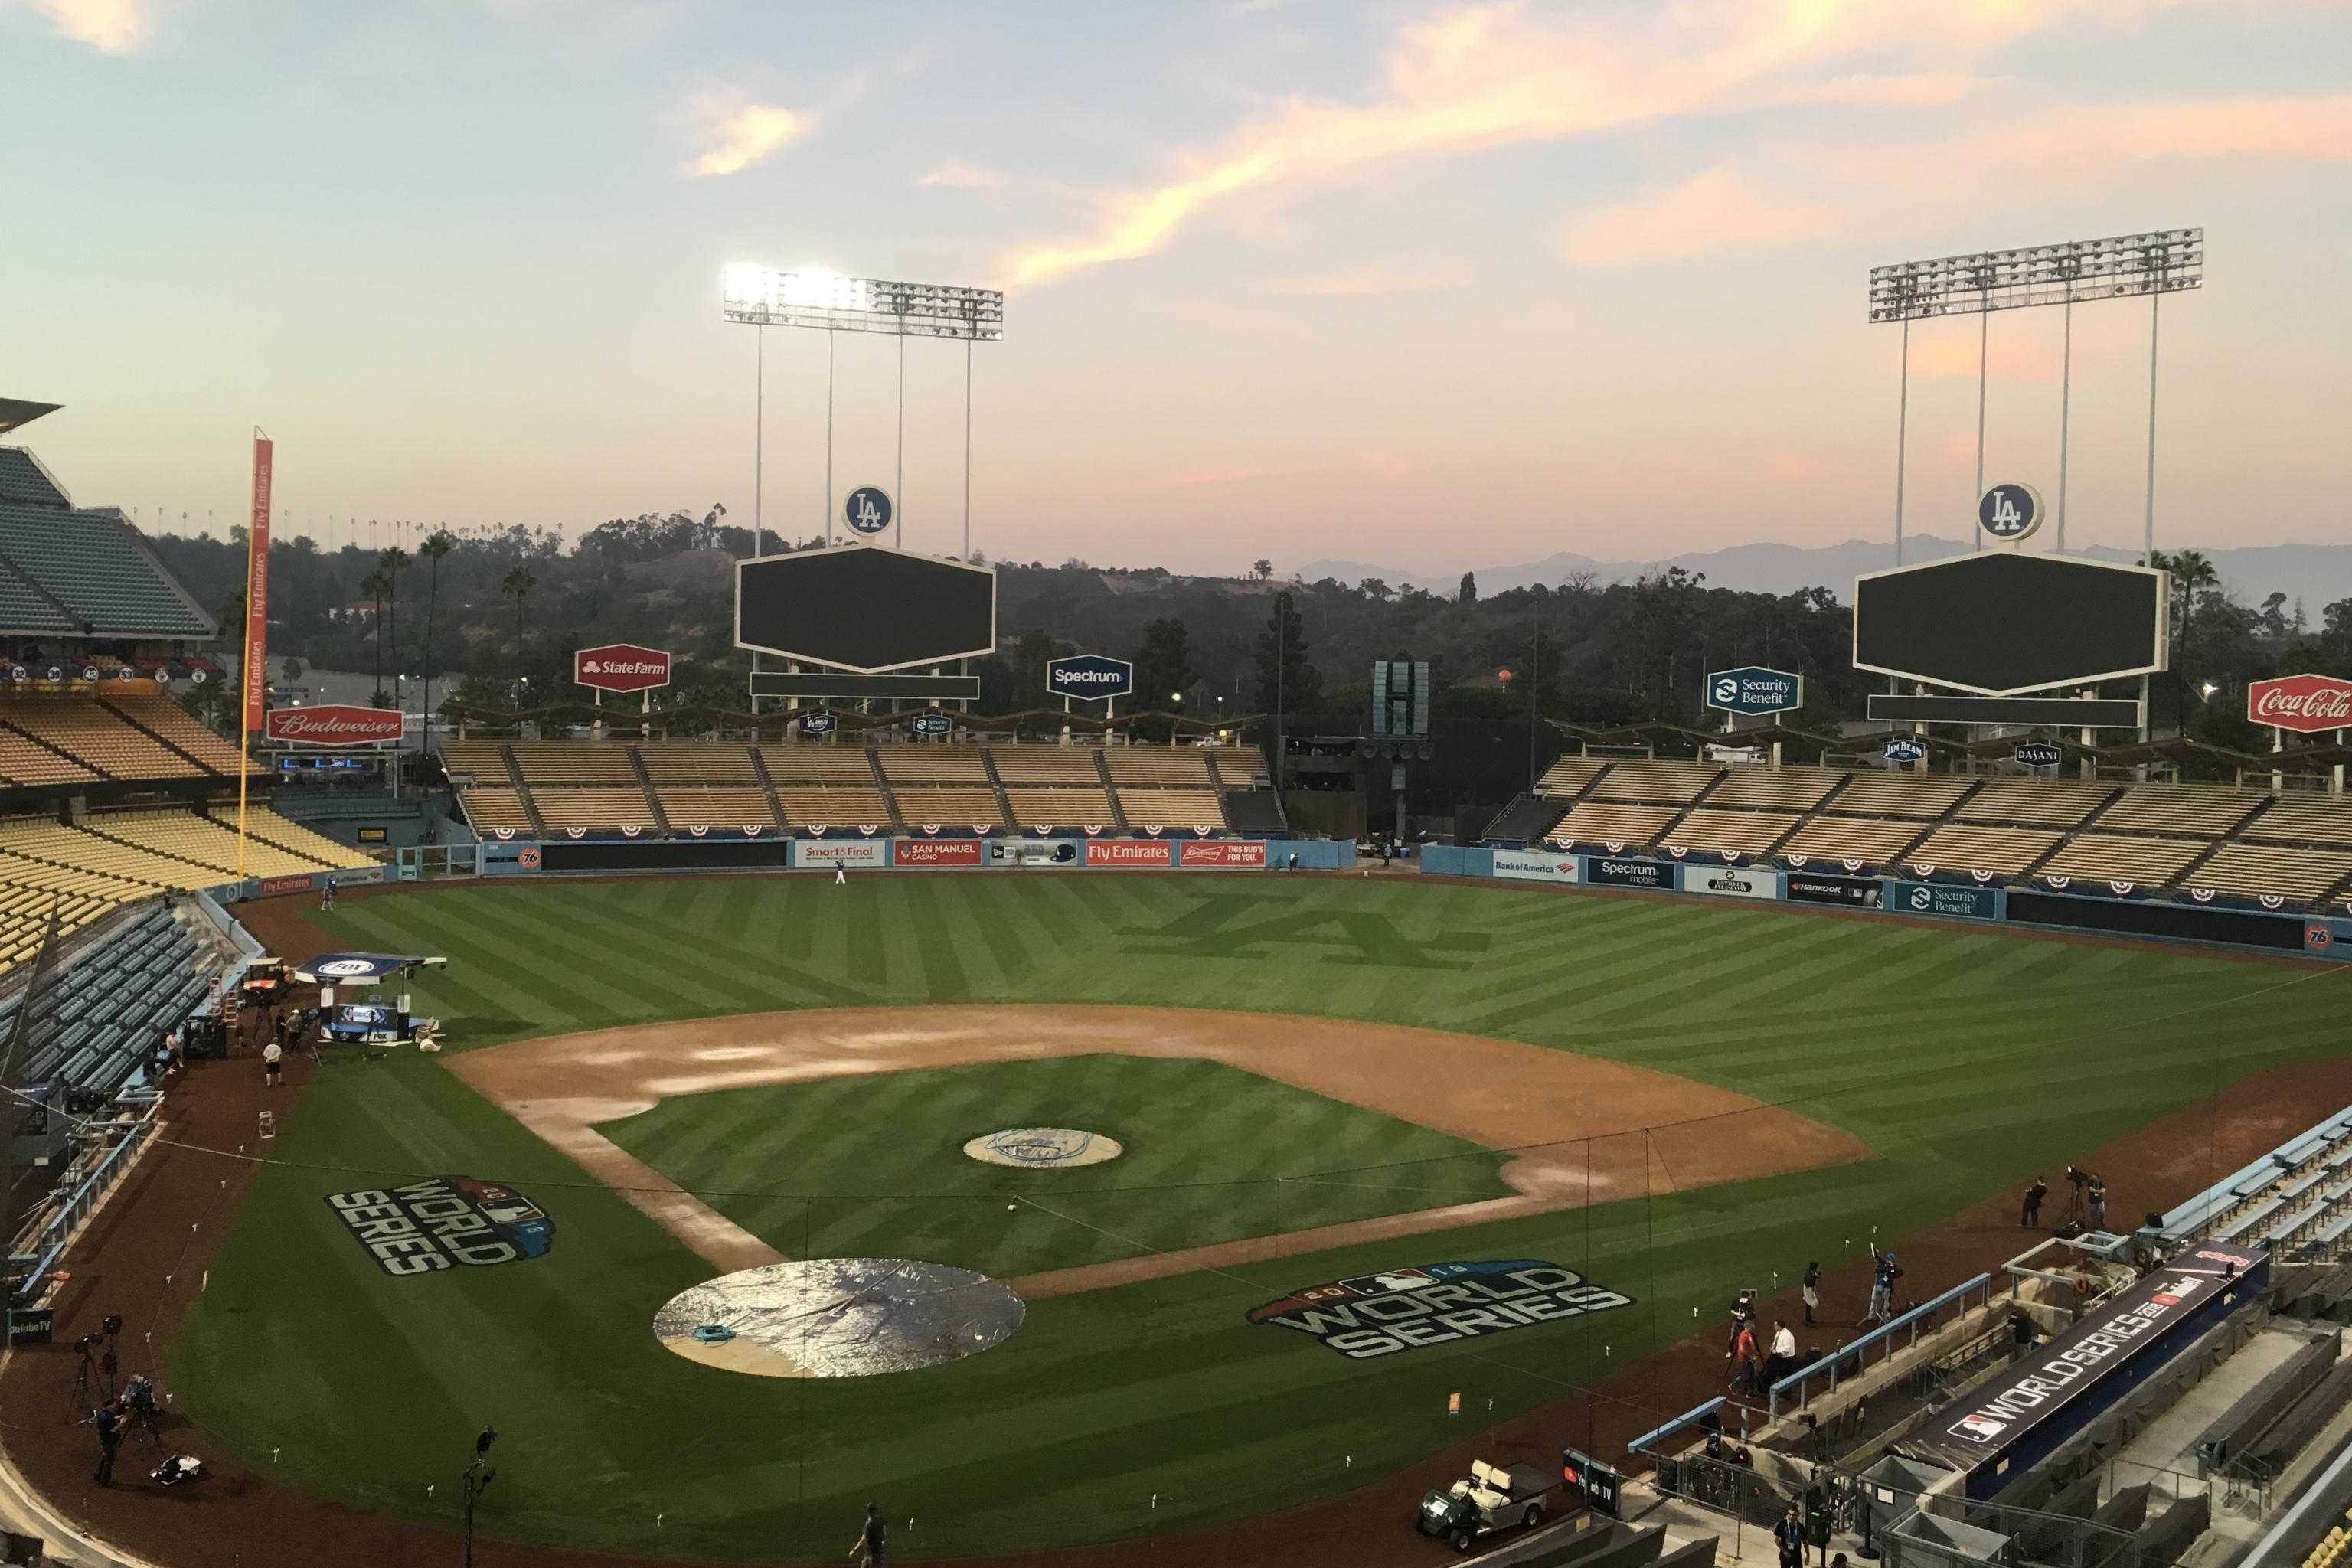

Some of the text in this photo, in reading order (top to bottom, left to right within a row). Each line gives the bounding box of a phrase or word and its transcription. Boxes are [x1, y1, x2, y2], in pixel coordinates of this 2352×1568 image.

[256, 464, 269, 528] Fly Emirates
[857, 493, 881, 528] LA
[1992, 492, 2021, 530] LA
[252, 553, 265, 617] Fly Emirates
[15, 670, 25, 678] 32
[85, 670, 97, 680] 42
[121, 671, 132, 680] 53
[249, 641, 262, 705] Fly Emirates
[1055, 668, 1120, 684] Spectrum
[1742, 679, 1790, 694] Security
[1743, 691, 1783, 704] Benefit
[2257, 688, 2352, 718] Coca-Cola
[275, 715, 400, 735] Budweiser
[1885, 743, 1900, 756] JIM
[1901, 741, 1922, 757] BEAM
[2018, 750, 2057, 761] DASANI
[805, 847, 839, 856] Smart
[848, 846, 873, 856] Final
[912, 844, 976, 854] SAN MANUEL
[1089, 845, 1169, 861] Fly Emirates
[523, 852, 537, 863] 76
[1496, 861, 1515, 871] Bank
[1524, 864, 1554, 873] America
[1602, 861, 1656, 875] Spectrum
[263, 883, 276, 891] Fly
[276, 879, 309, 890] Emirates
[1629, 876, 1656, 884] mobile
[1935, 889, 1978, 904] Security
[1935, 900, 1971, 913] Benefit
[2309, 929, 2328, 944] 76
[482, 1187, 507, 1200] 20
[393, 1178, 517, 1265] WORLD
[328, 1190, 452, 1276] SERIES
[1303, 1264, 1468, 1300] 20 18
[1267, 1268, 1582, 1334] WORLD
[1325, 1285, 1631, 1358] SERIES
[1976, 1360, 2084, 1421] WORLD
[2060, 1313, 2155, 1366] SERIES
